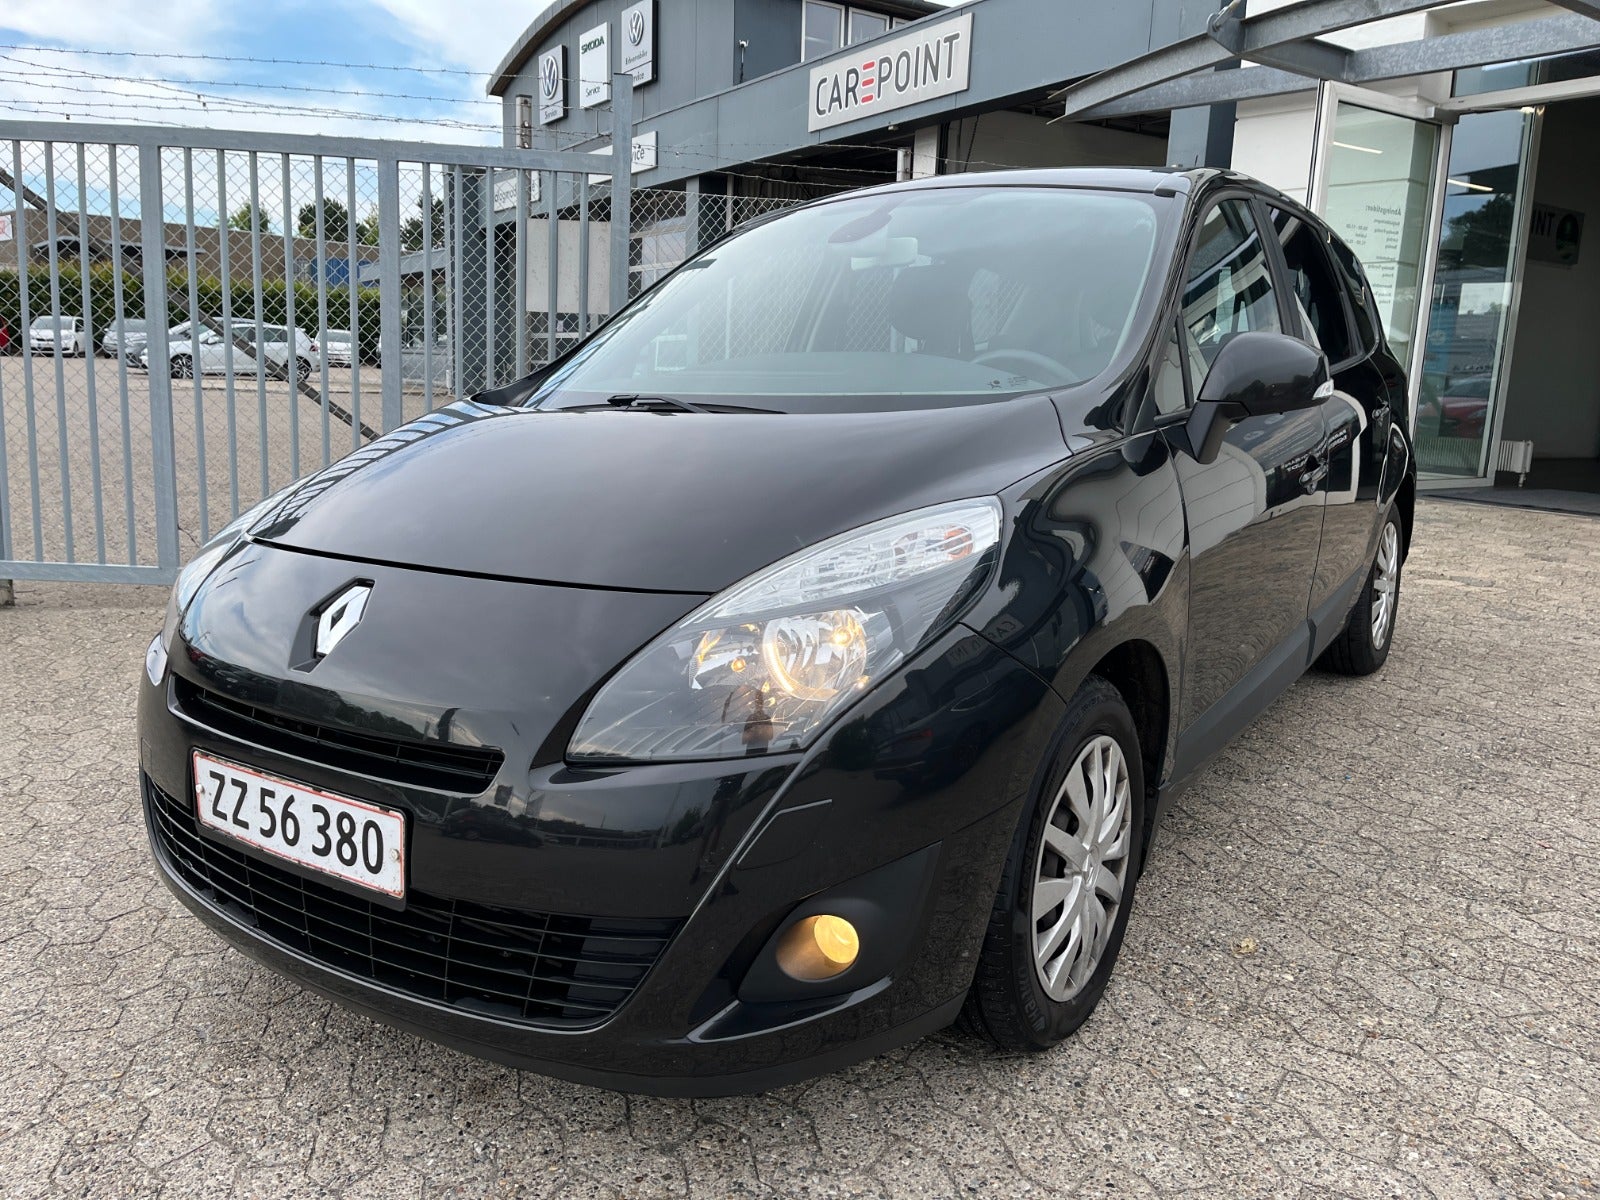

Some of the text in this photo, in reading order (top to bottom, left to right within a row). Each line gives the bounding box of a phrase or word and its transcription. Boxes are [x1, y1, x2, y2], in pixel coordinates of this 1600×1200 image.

[585, 85, 601, 97] Service
[633, 71, 645, 83] rvice
[816, 33, 960, 116] CAREPOINT
[209, 770, 384, 875] ZZ 56 380
